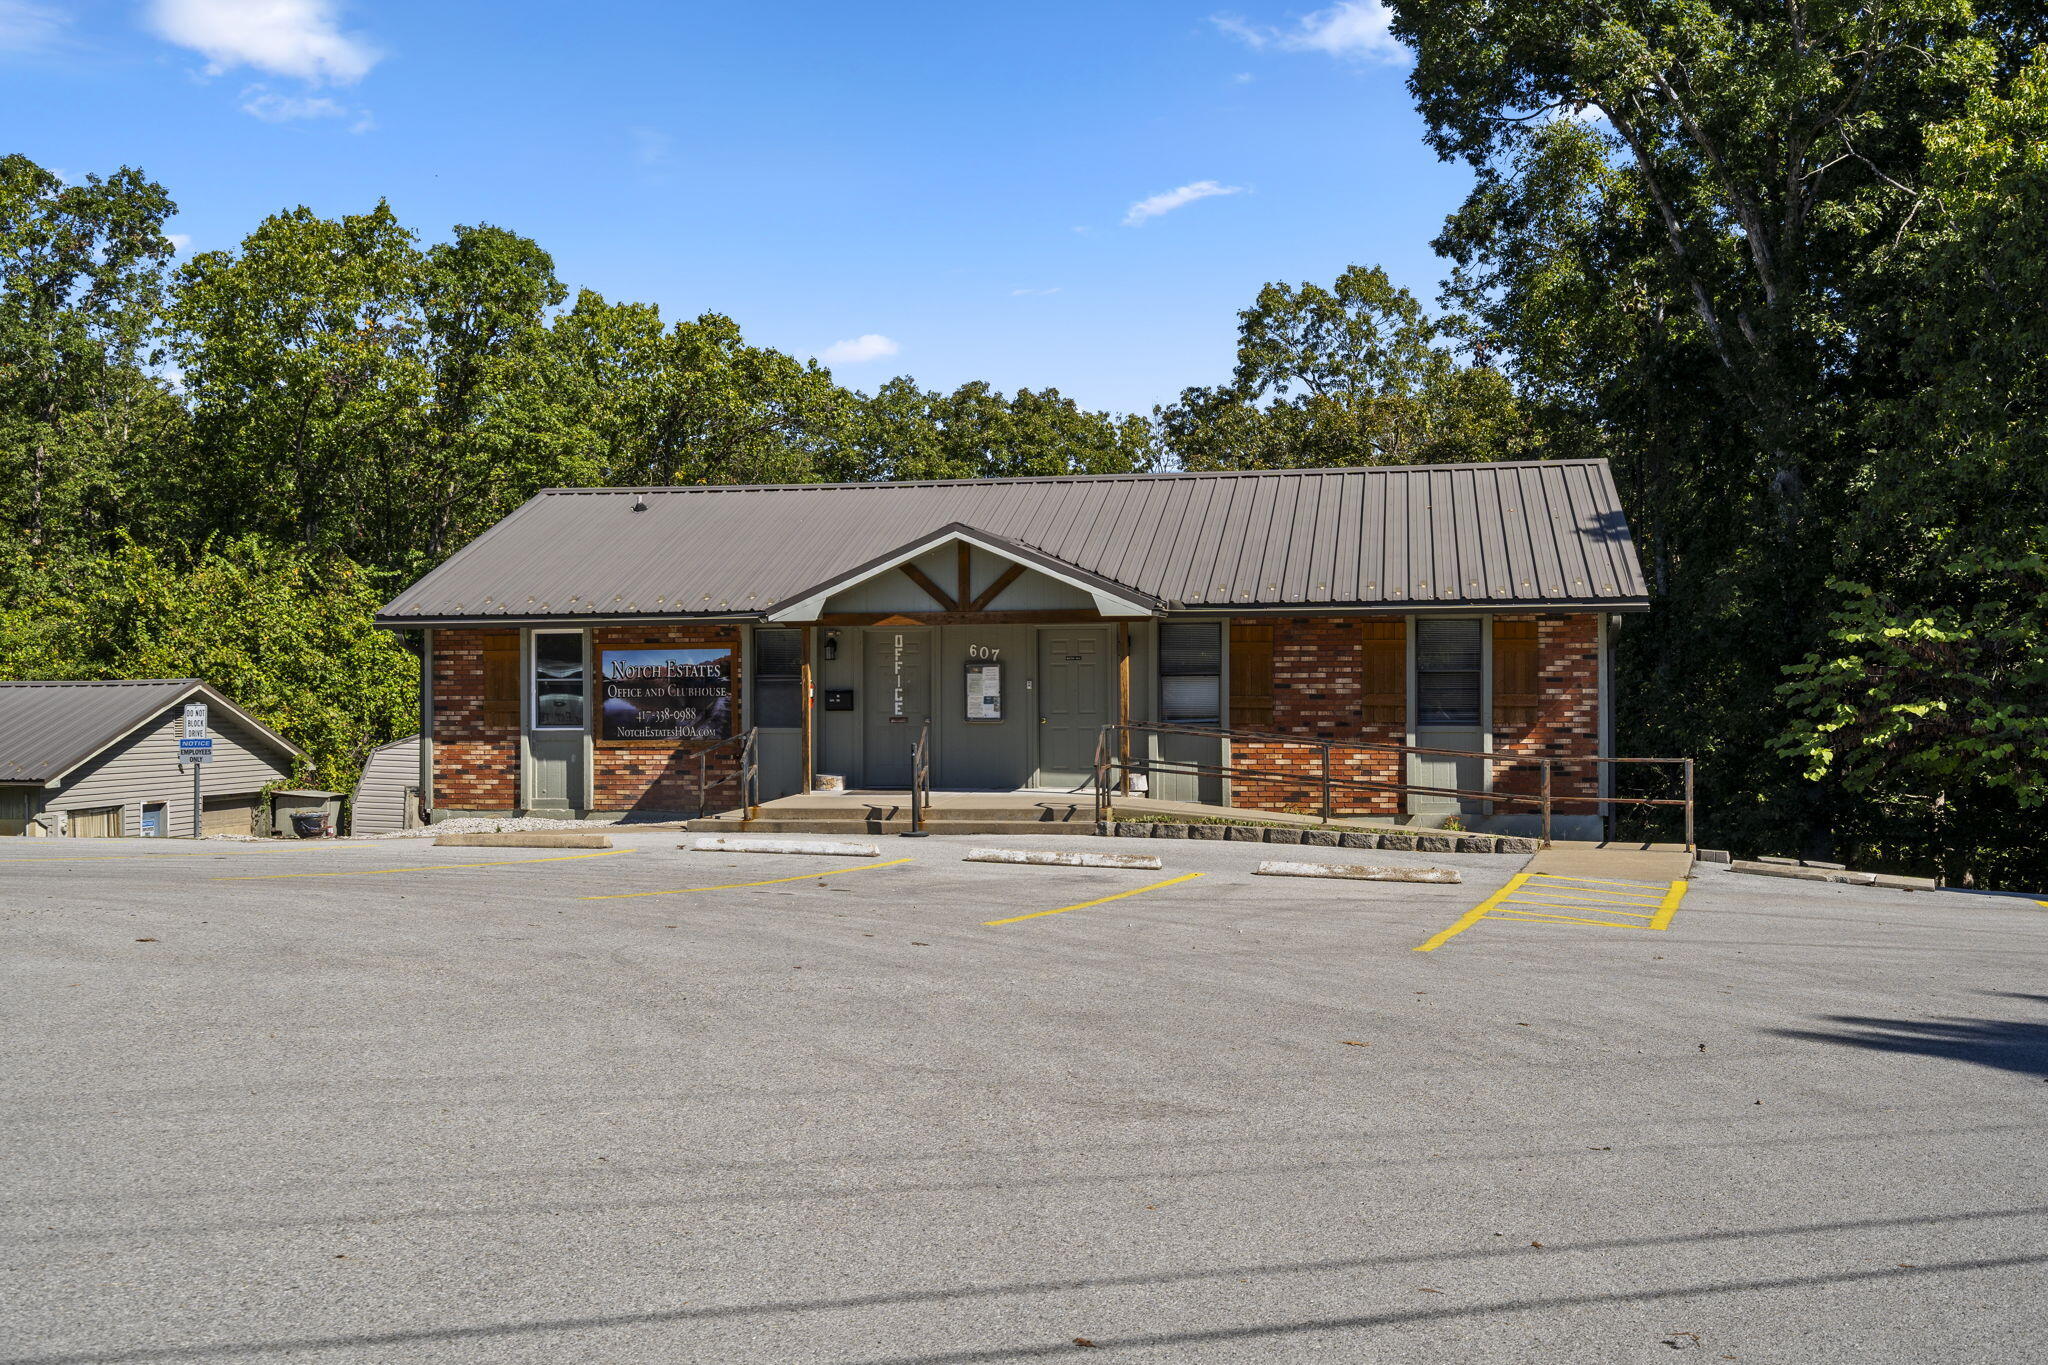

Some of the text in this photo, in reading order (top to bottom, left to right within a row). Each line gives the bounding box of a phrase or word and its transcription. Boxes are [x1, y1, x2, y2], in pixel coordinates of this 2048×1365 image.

[969, 644, 1000, 661] 607
[611, 659, 721, 679] NOTCH ESTATES
[895, 635, 903, 715] OFFICE
[608, 685, 642, 698] OFFICE
[637, 708, 697, 722] 417-338-0988
